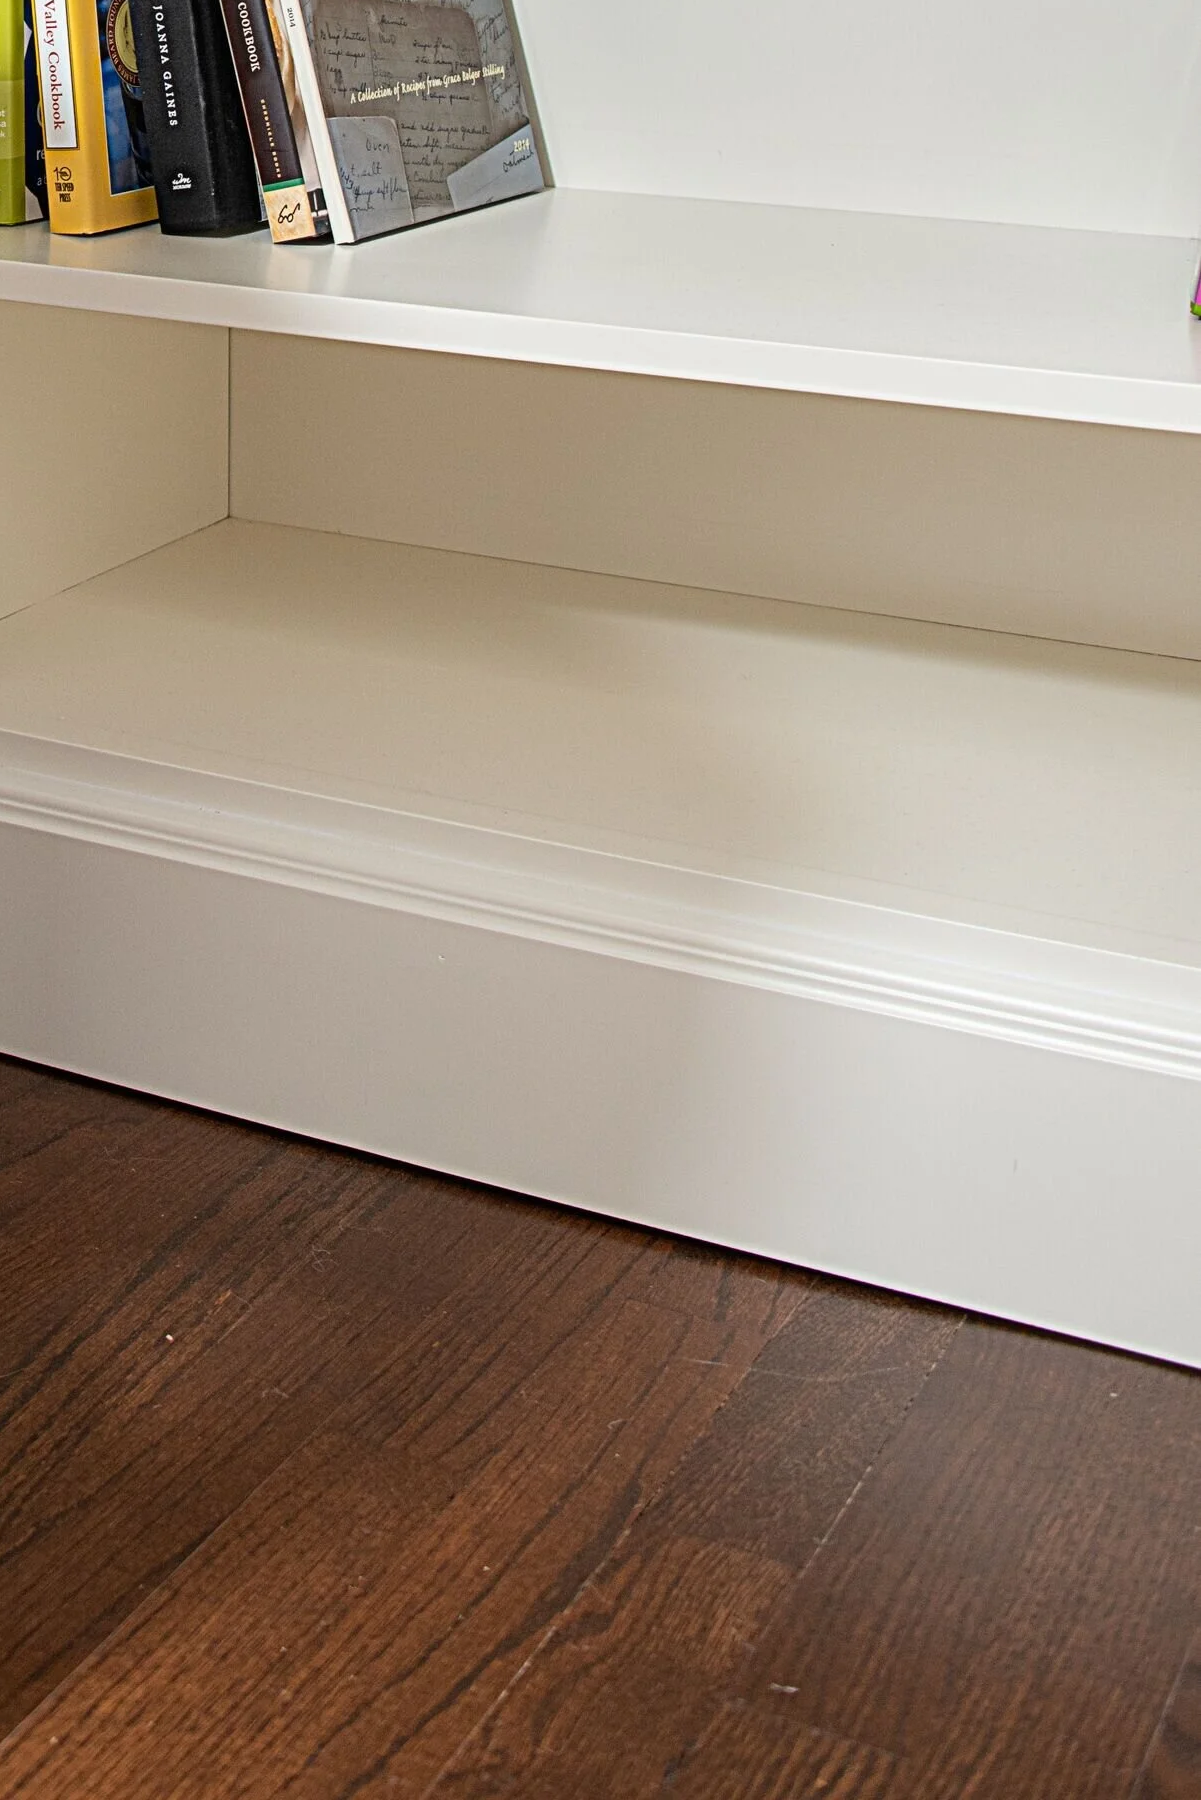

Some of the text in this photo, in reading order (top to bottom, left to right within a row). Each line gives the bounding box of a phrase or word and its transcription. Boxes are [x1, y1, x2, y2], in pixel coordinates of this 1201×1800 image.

[237, 1, 260, 73] COOKBOOK
[286, 7, 296, 28] 2014
[48, 52, 65, 130] Cookbook
[153, 5, 178, 126] JOANNA GAINES
[350, 93, 356, 104] A
[357, 87, 392, 102] Collection
[393, 81, 400, 101] of
[401, 79, 426, 96] Recipes
[426, 75, 443, 94] from
[443, 73, 462, 88] Grace
[461, 67, 481, 86] Bolger
[513, 138, 530, 152] 2014
